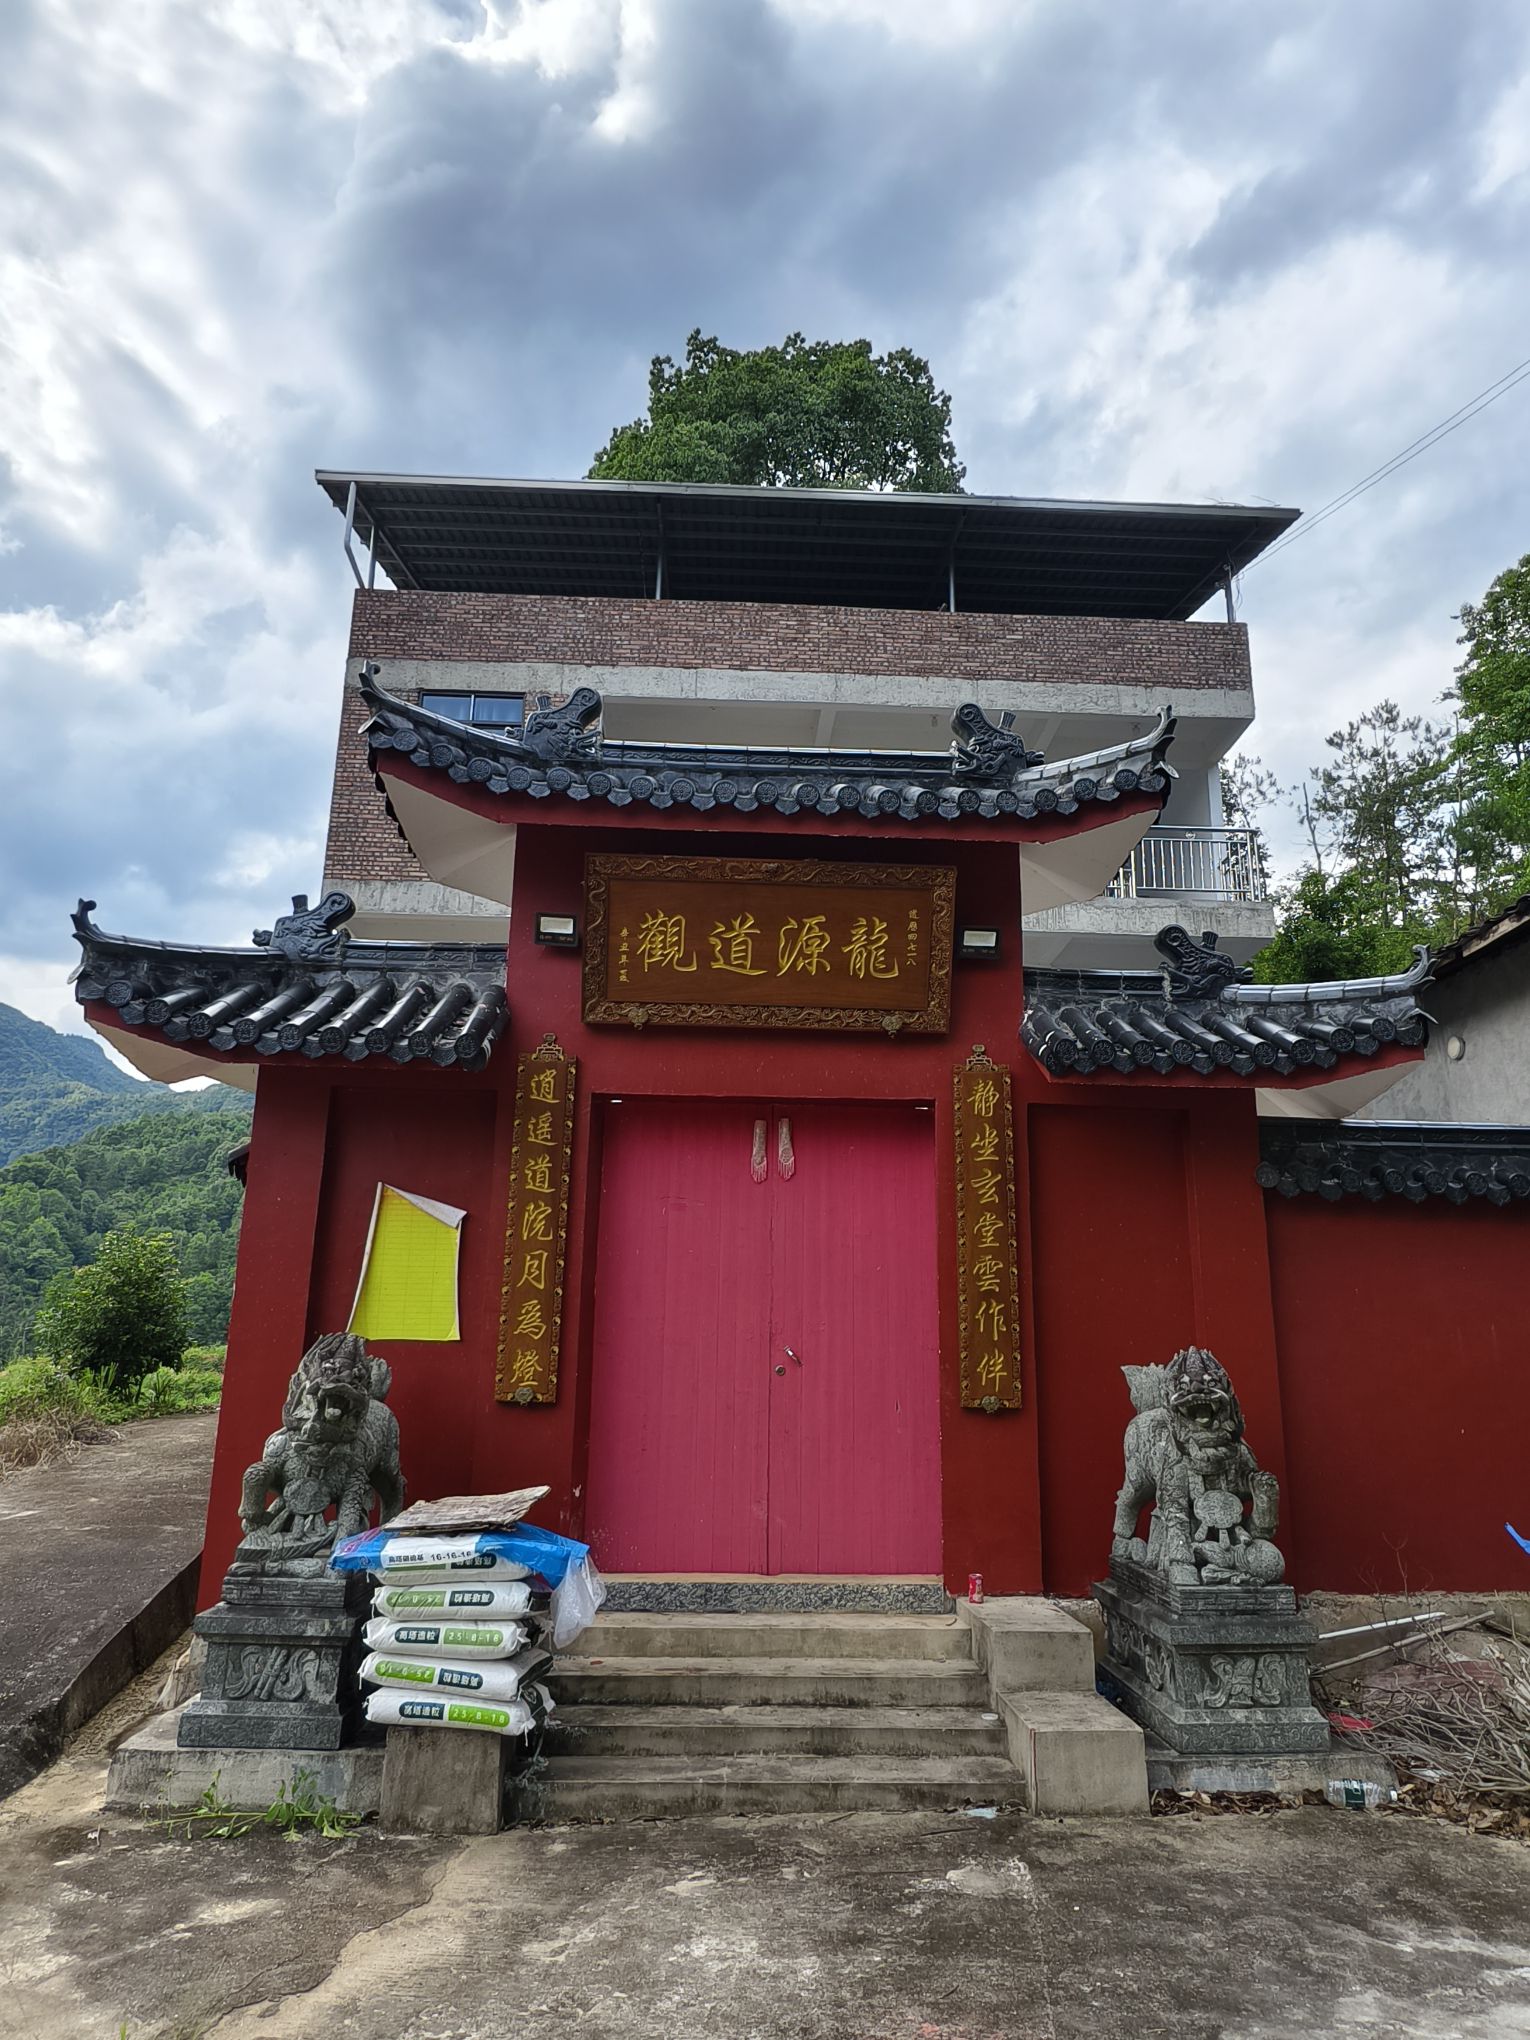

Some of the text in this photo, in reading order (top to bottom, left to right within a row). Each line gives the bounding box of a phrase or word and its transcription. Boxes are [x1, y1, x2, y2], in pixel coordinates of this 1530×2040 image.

[636, 908, 900, 979] 龍源道觀
[399, 1629, 436, 1641] 高塔造粒
[403, 1703, 441, 1717] 高塔造粒
